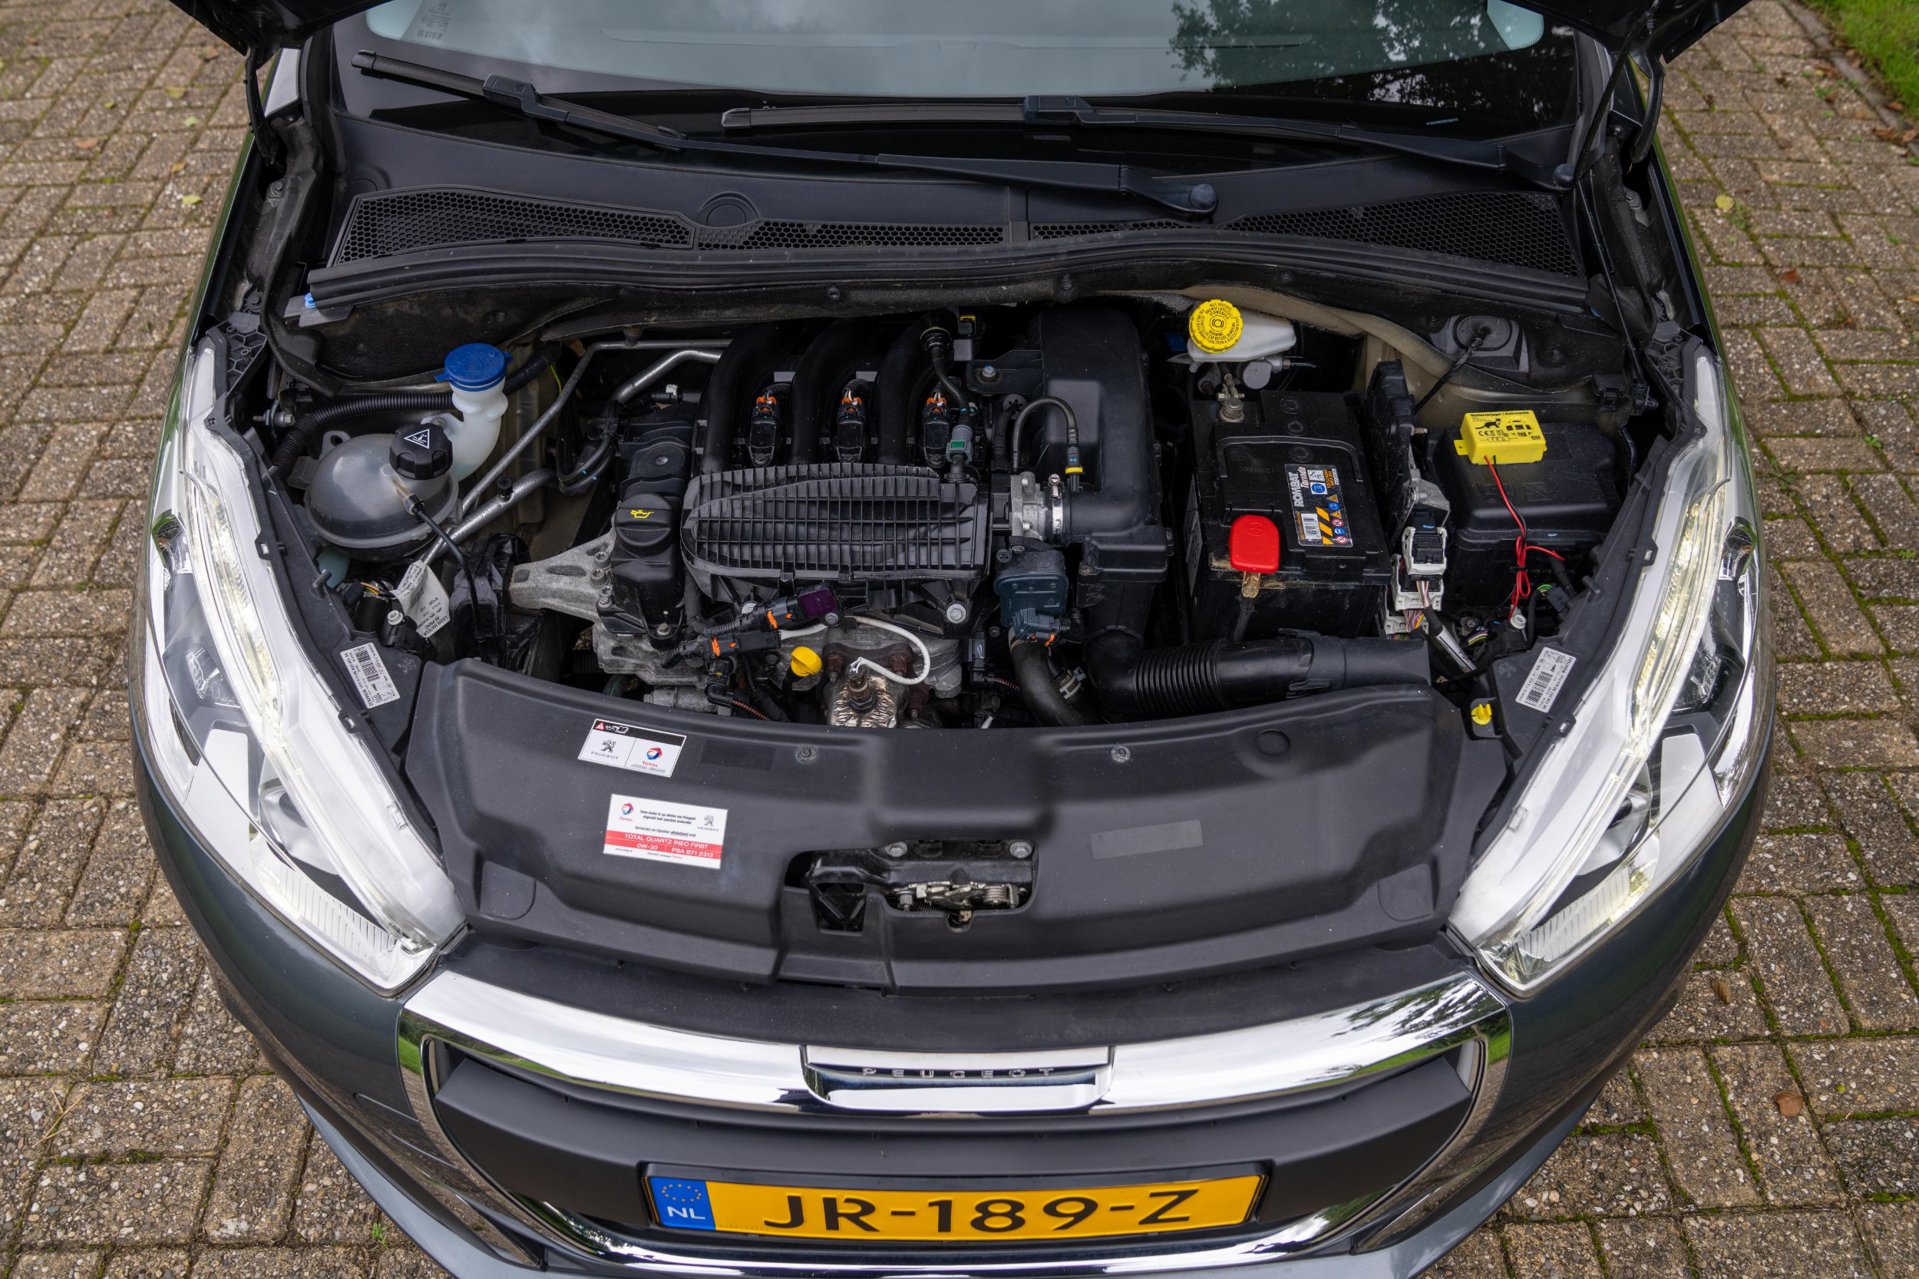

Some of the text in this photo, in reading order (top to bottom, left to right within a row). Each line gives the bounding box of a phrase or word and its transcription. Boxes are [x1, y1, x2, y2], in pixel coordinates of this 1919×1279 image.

[1288, 472, 1304, 507] ROMBAT
[591, 751, 618, 760] PEUGEOT
[624, 833, 645, 841] TOTAL
[646, 836, 673, 845] QUARTZ
[671, 847, 685, 855] PSA
[862, 1067, 1054, 1079] PEUGEOT
[667, 1207, 706, 1222] NL
[764, 1189, 1200, 1233] JR-189-Z
